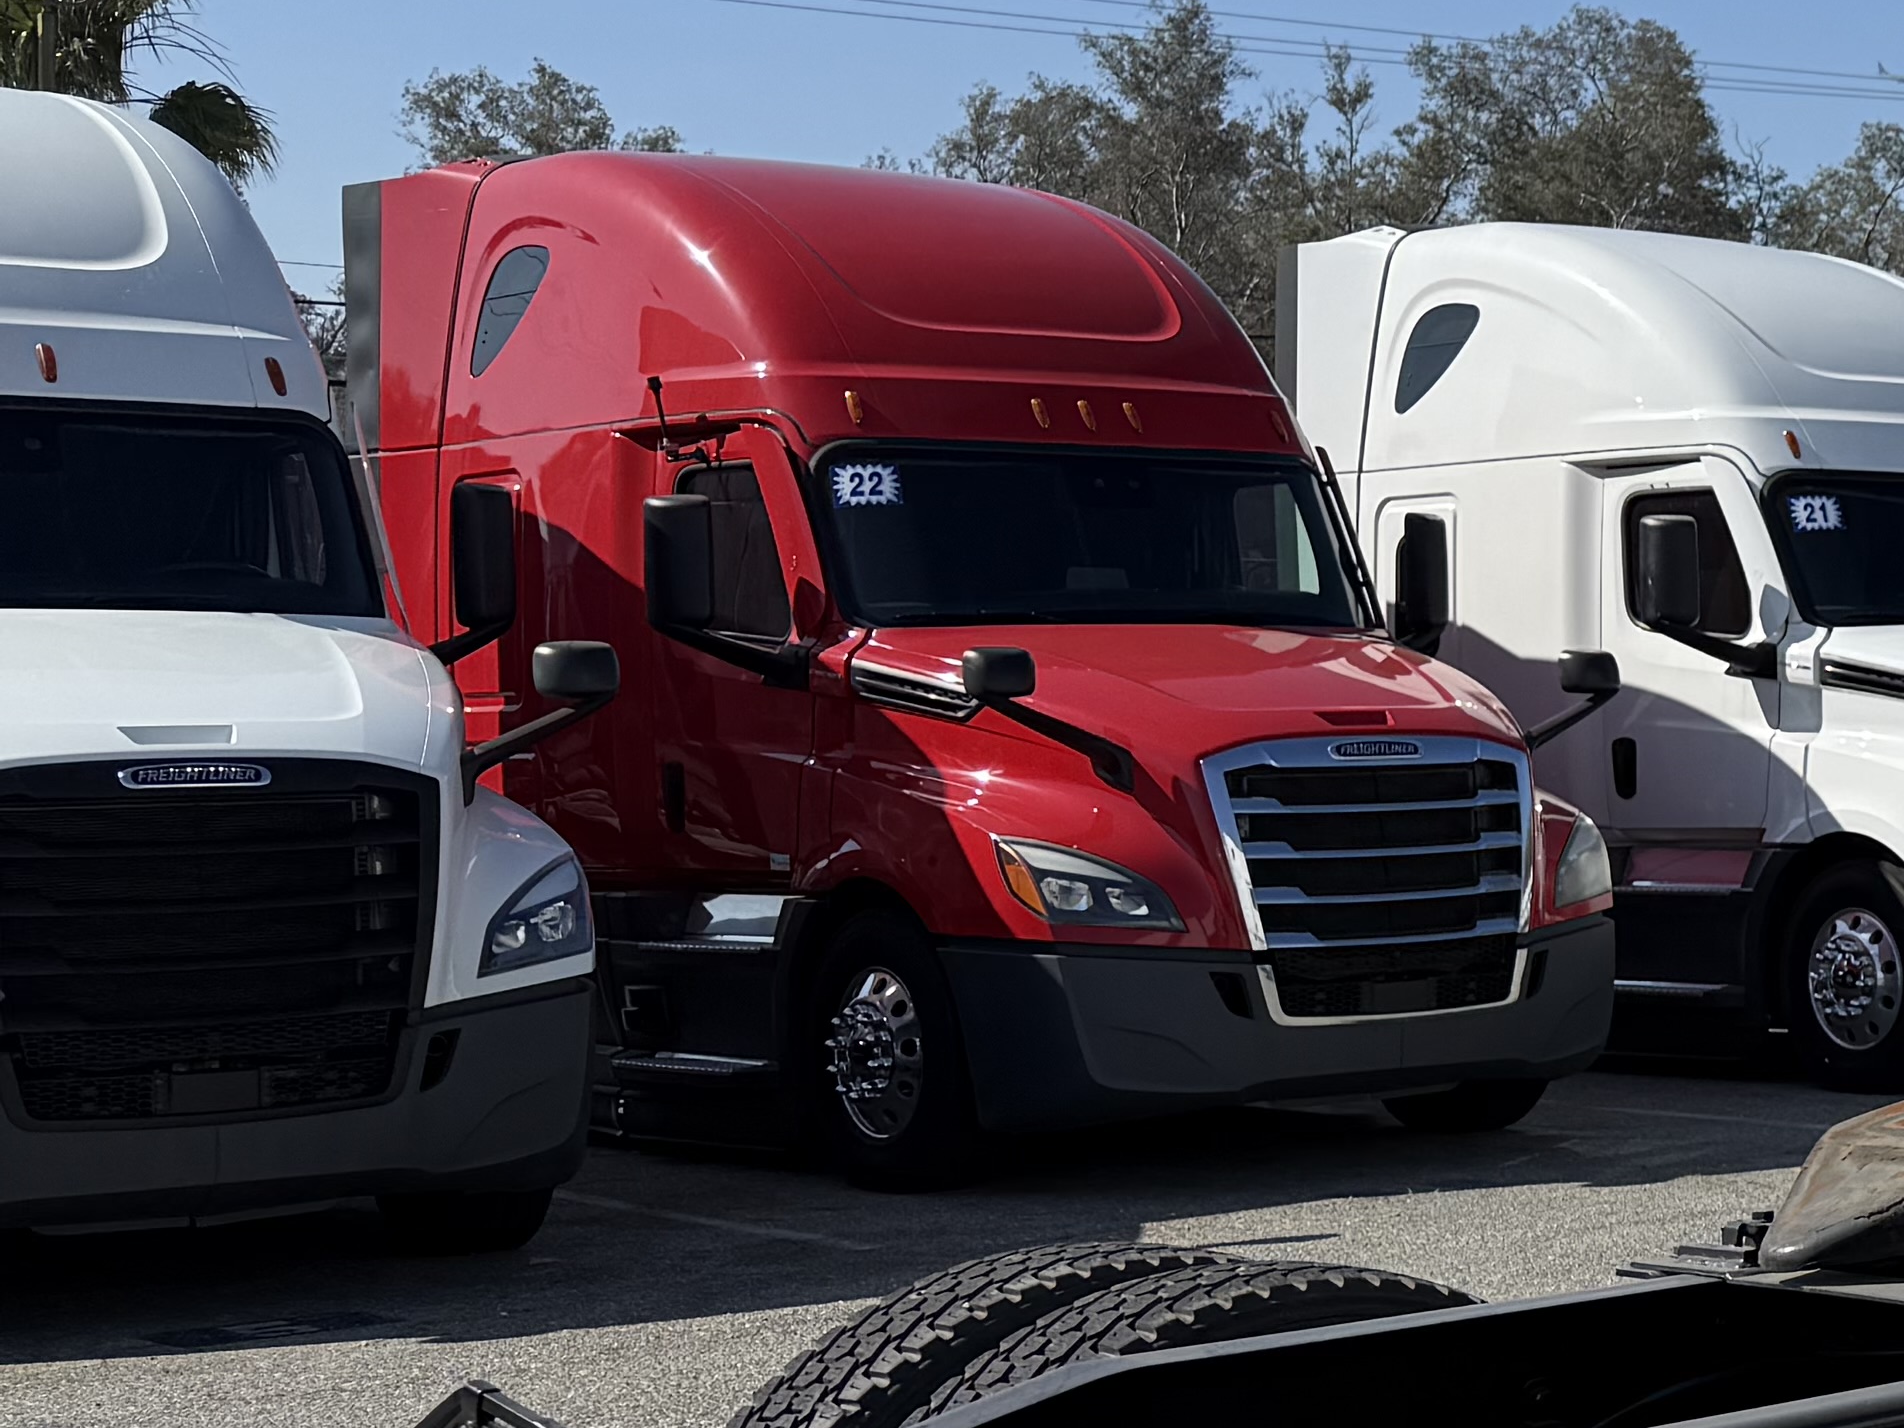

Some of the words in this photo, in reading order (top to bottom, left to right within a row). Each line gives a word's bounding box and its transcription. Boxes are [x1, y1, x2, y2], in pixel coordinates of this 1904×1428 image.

[849, 471, 884, 498] 22
[1803, 501, 1829, 524] 21
[138, 767, 256, 783] FREIGHTLINER
